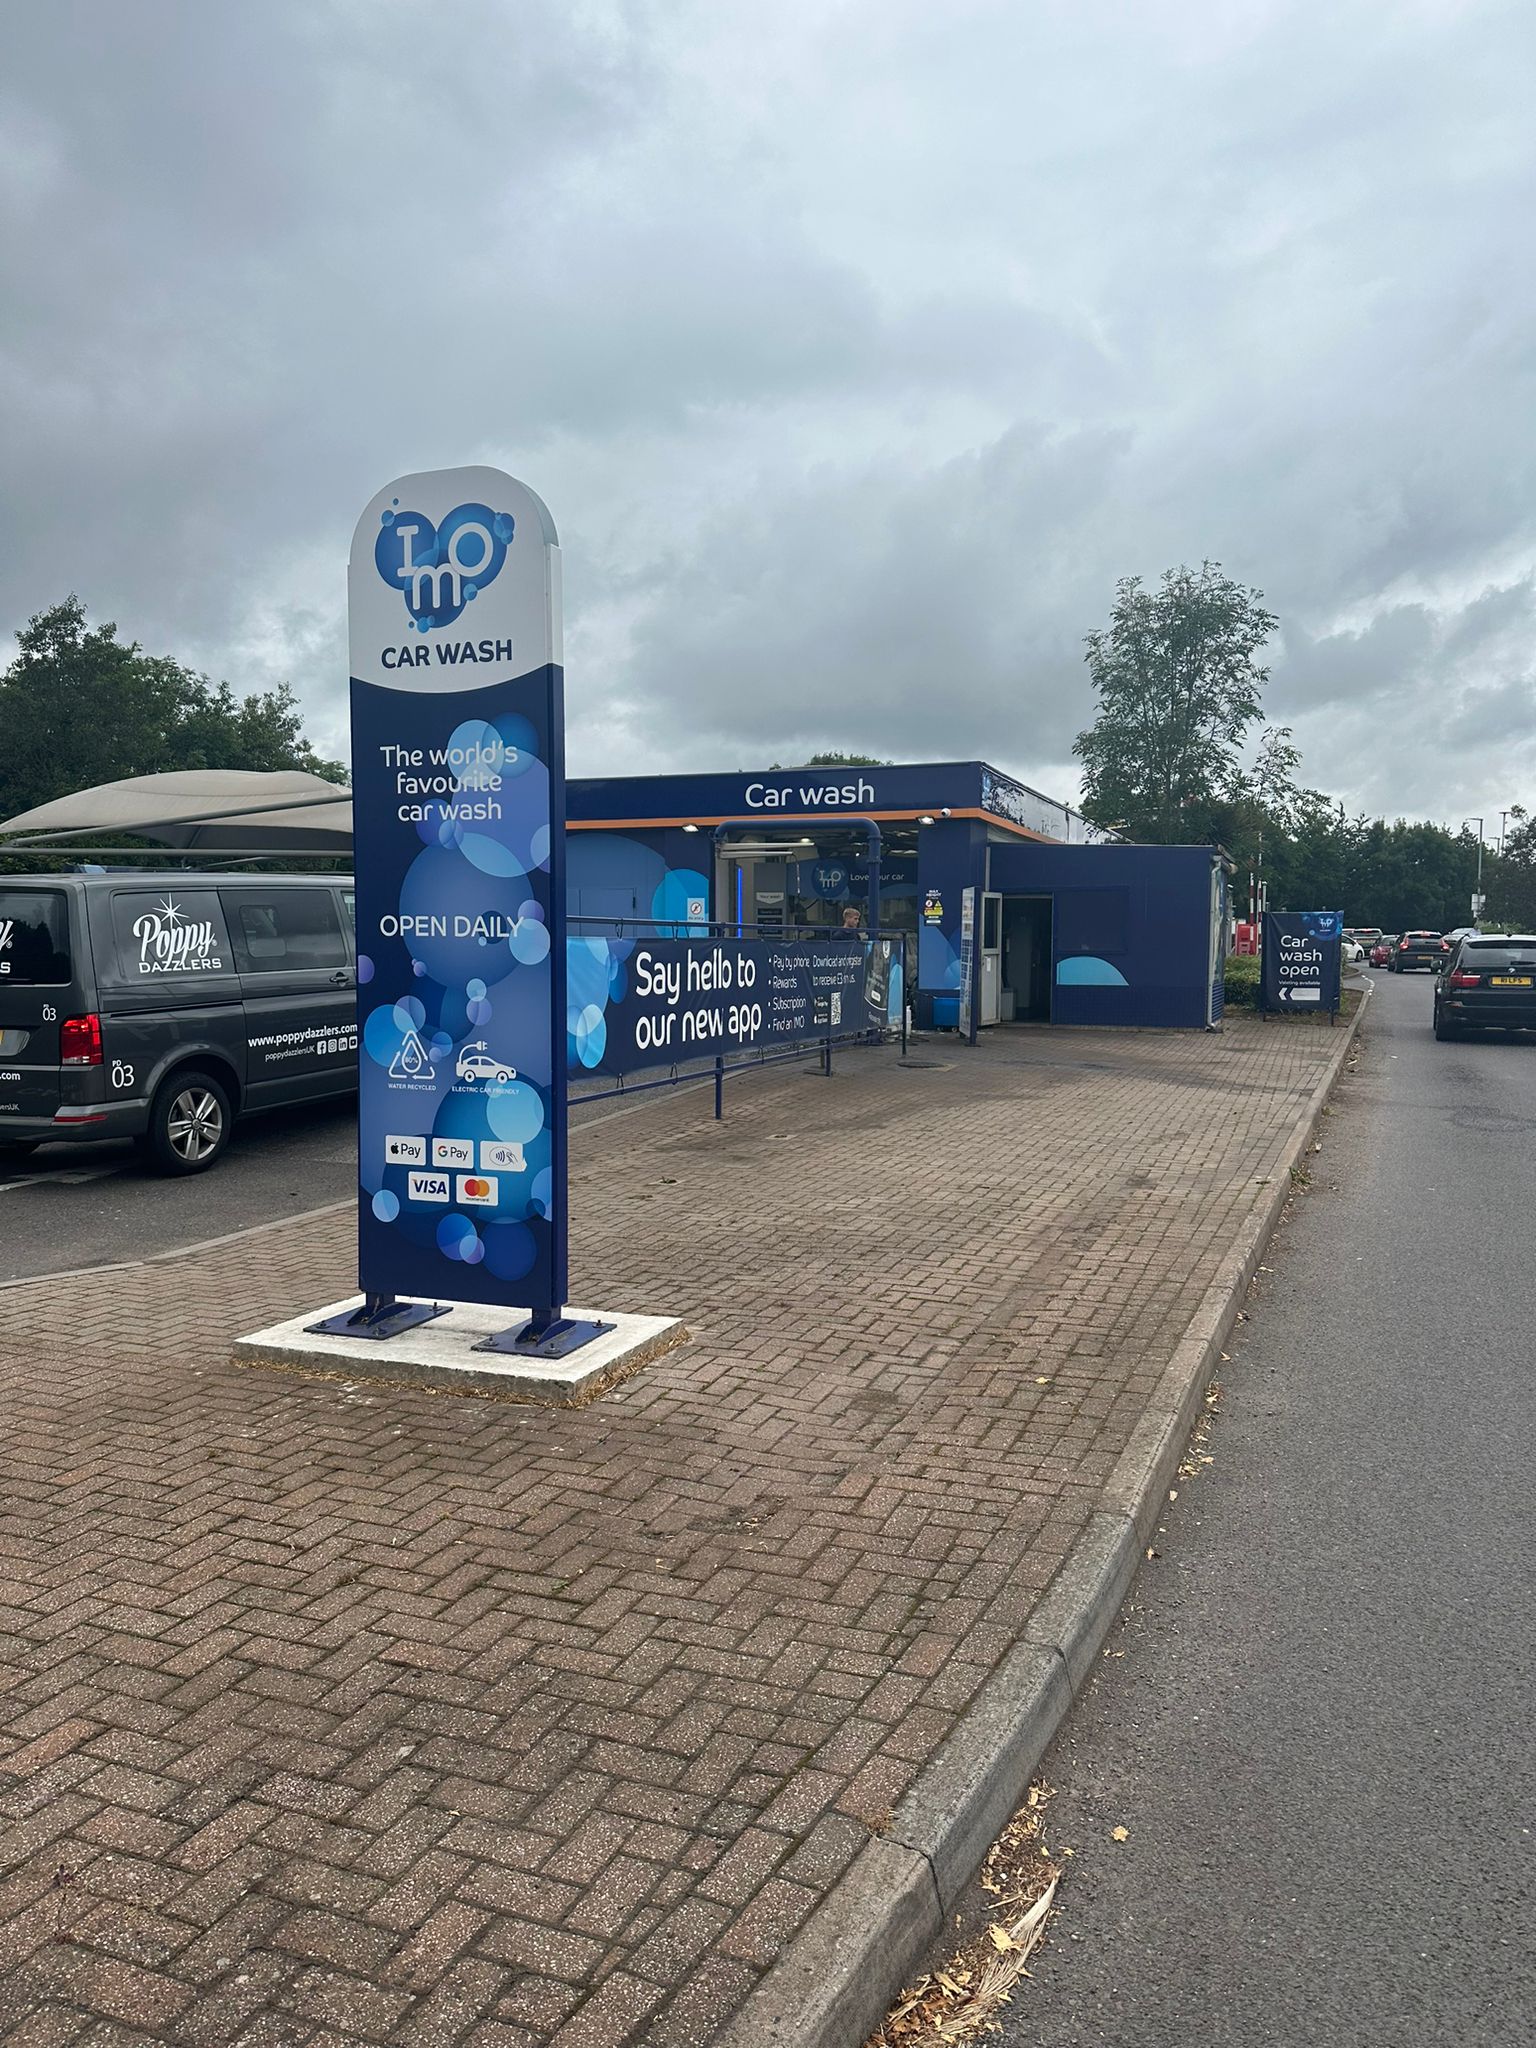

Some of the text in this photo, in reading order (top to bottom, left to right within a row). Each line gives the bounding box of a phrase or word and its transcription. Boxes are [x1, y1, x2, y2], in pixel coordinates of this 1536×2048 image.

[381, 639, 512, 668] CAR WASH
[380, 740, 518, 767] The world's
[397, 769, 502, 794] favourite
[745, 778, 875, 807] Car wash
[398, 797, 502, 821] car wash
[380, 915, 525, 938] OPEN DAILY
[133, 914, 215, 964] Poppy
[1280, 935, 1308, 947] Car
[773, 954, 810, 971] Pay by phone
[1280, 949, 1322, 962] wash
[139, 958, 222, 973] DAZZLERS
[1280, 965, 1320, 978] open
[636, 948, 756, 1005] Say hello to
[773, 976, 797, 989] Rewards
[773, 997, 806, 1011] Subscription
[43, 1008, 56, 1020] 03
[636, 1003, 762, 1049] our new app
[773, 1018, 785, 1031] Find
[785, 1019, 793, 1030] an
[248, 1024, 358, 1047] www.poppydazzlers.com
[112, 1065, 134, 1088] 03
[401, 1143, 421, 1158] Pay
[450, 1147, 468, 1161] Pay
[413, 1179, 447, 1194] VISA
